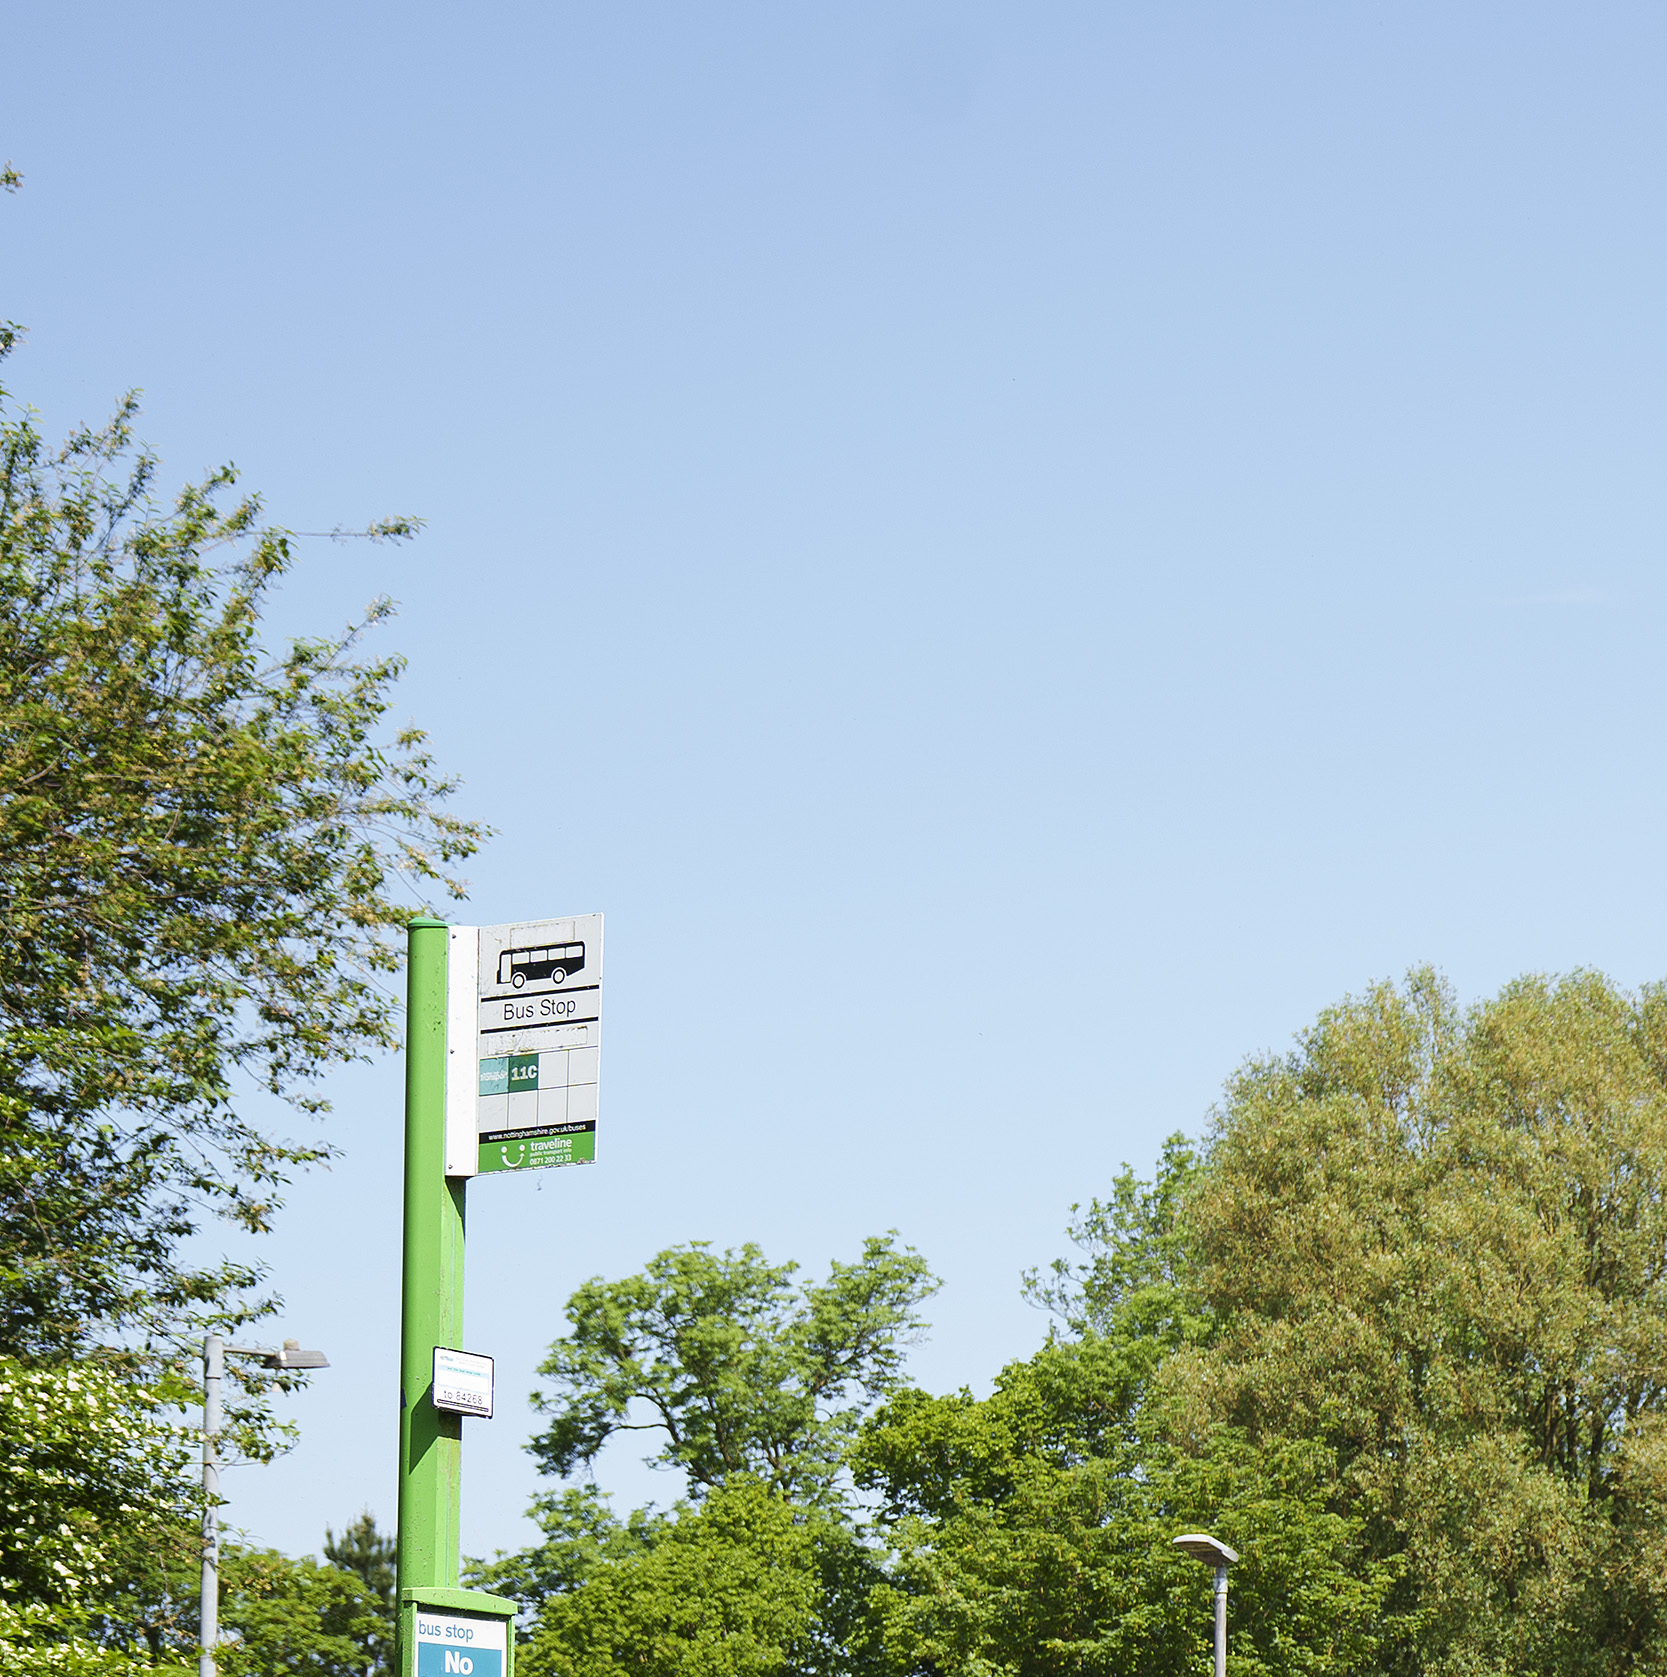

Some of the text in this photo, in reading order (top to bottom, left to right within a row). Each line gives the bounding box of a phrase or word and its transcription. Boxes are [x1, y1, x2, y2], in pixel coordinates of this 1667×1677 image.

[504, 999, 576, 1020] Bus Stop
[511, 1065, 538, 1081] 11C
[530, 1138, 573, 1152] traveline
[419, 1620, 474, 1642] bus stop
[445, 1650, 474, 1675] No
